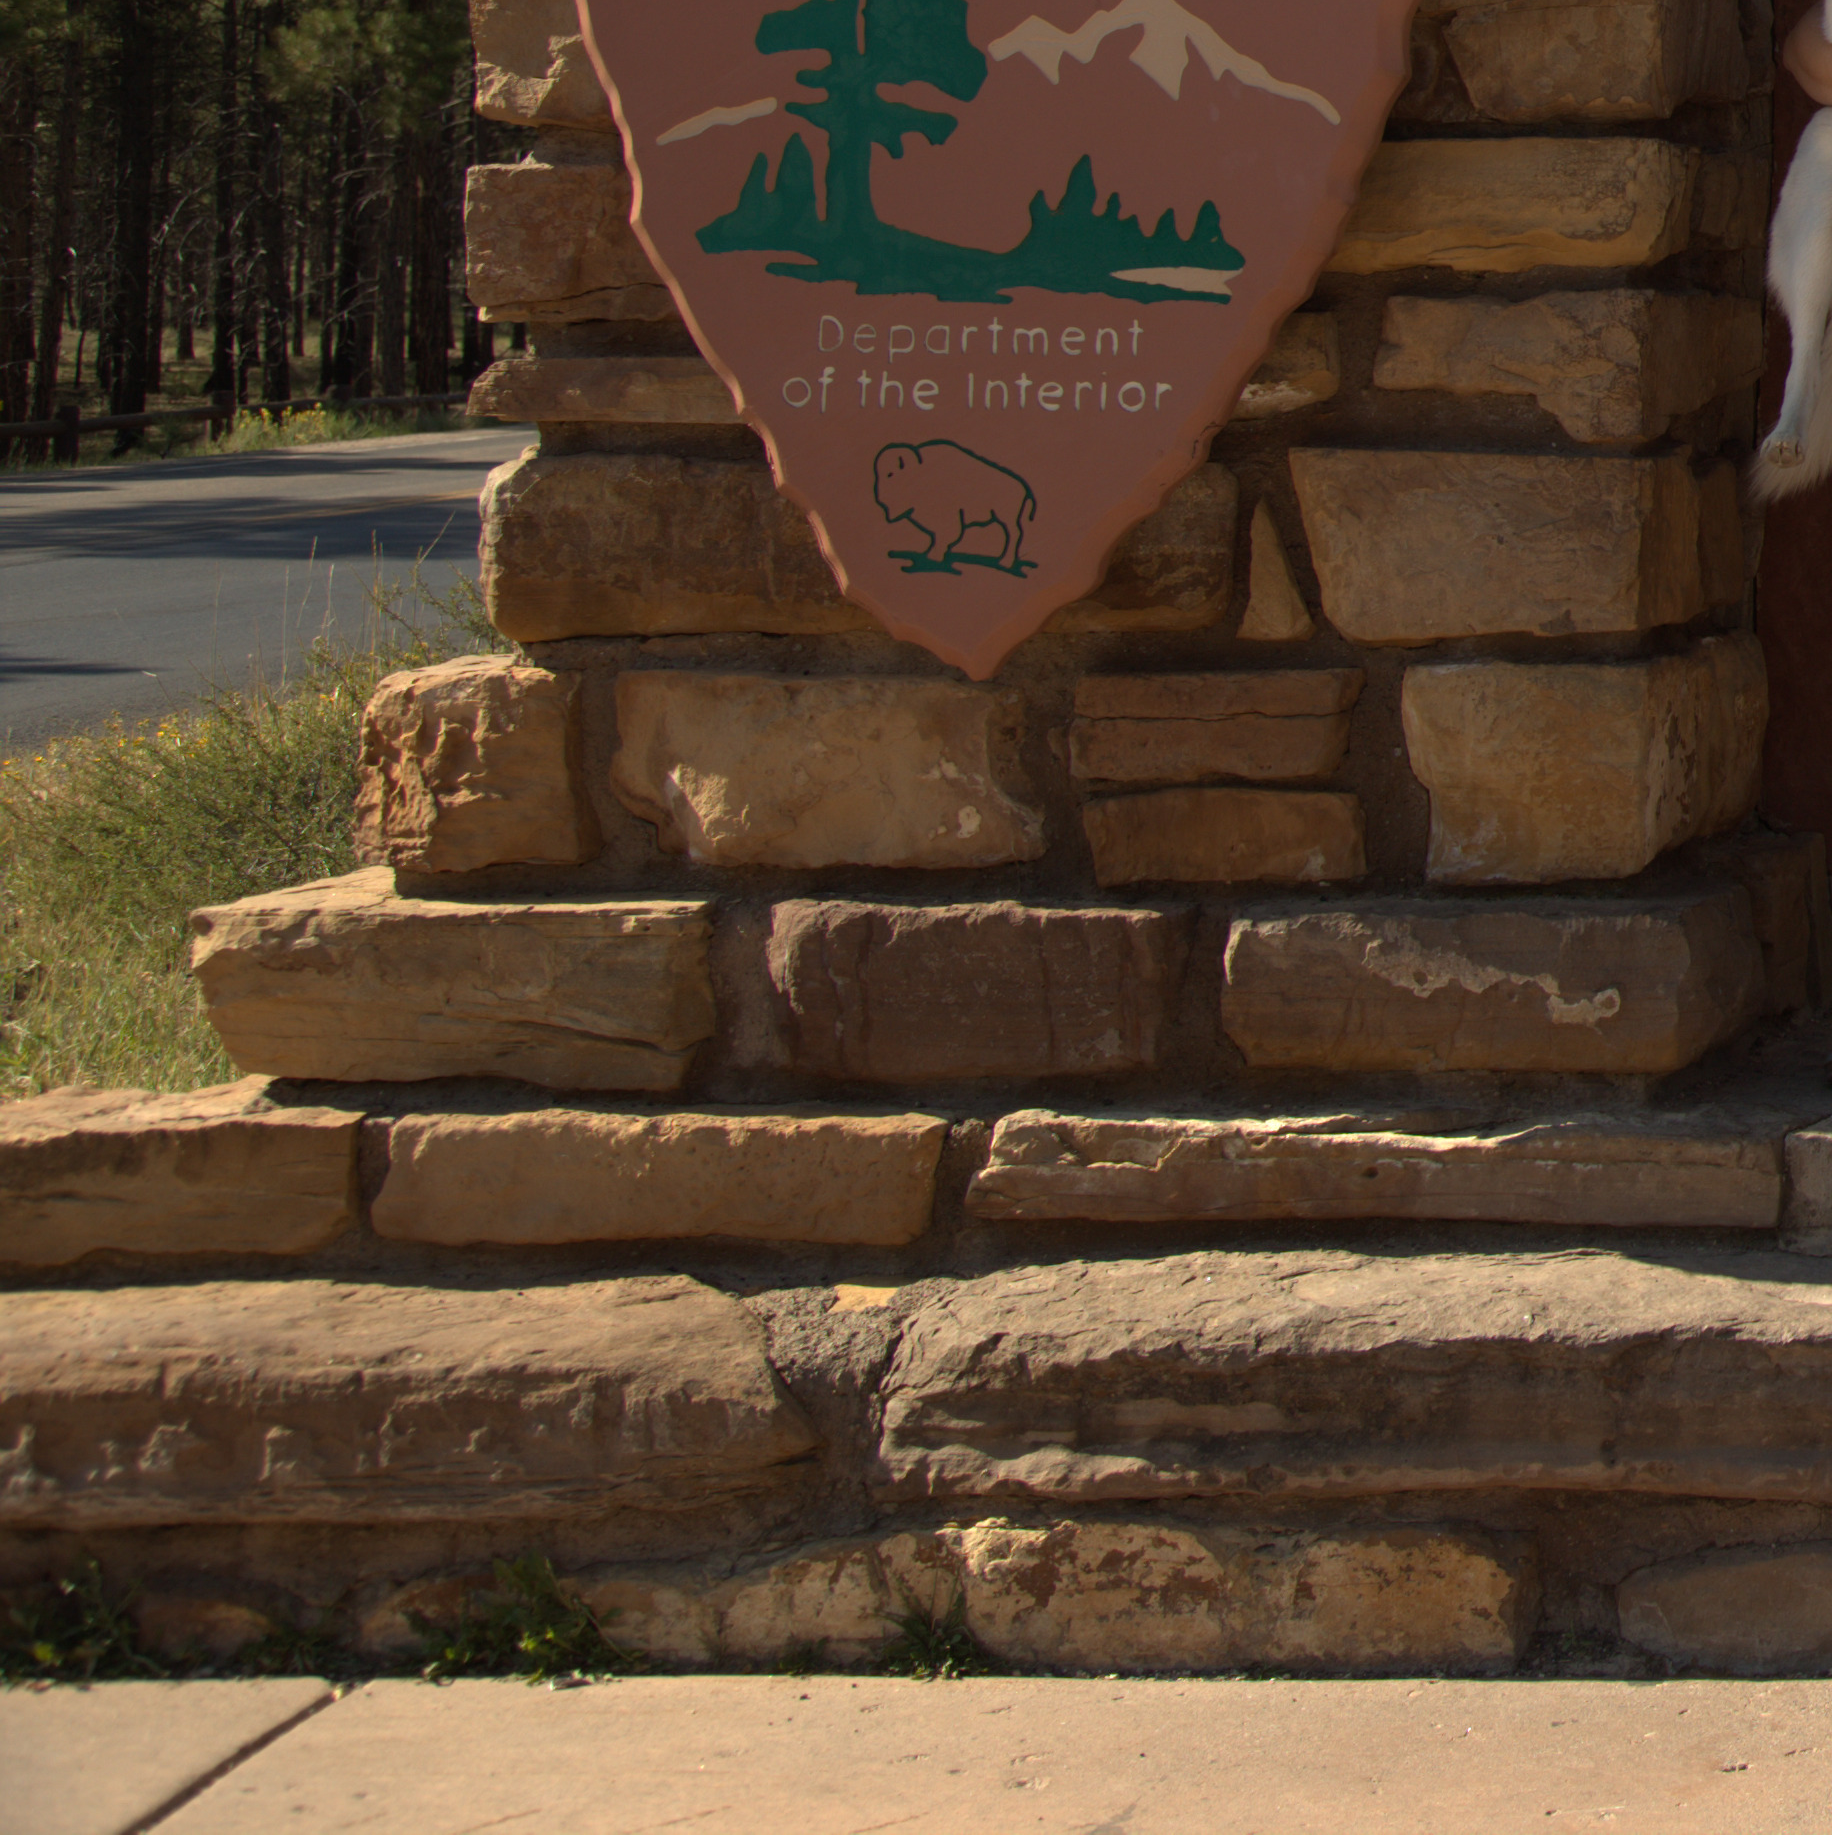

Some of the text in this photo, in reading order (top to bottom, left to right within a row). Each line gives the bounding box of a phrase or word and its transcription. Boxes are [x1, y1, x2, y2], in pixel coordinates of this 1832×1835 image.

[818, 315, 1145, 363] Department
[782, 367, 1172, 413] of the Interior
